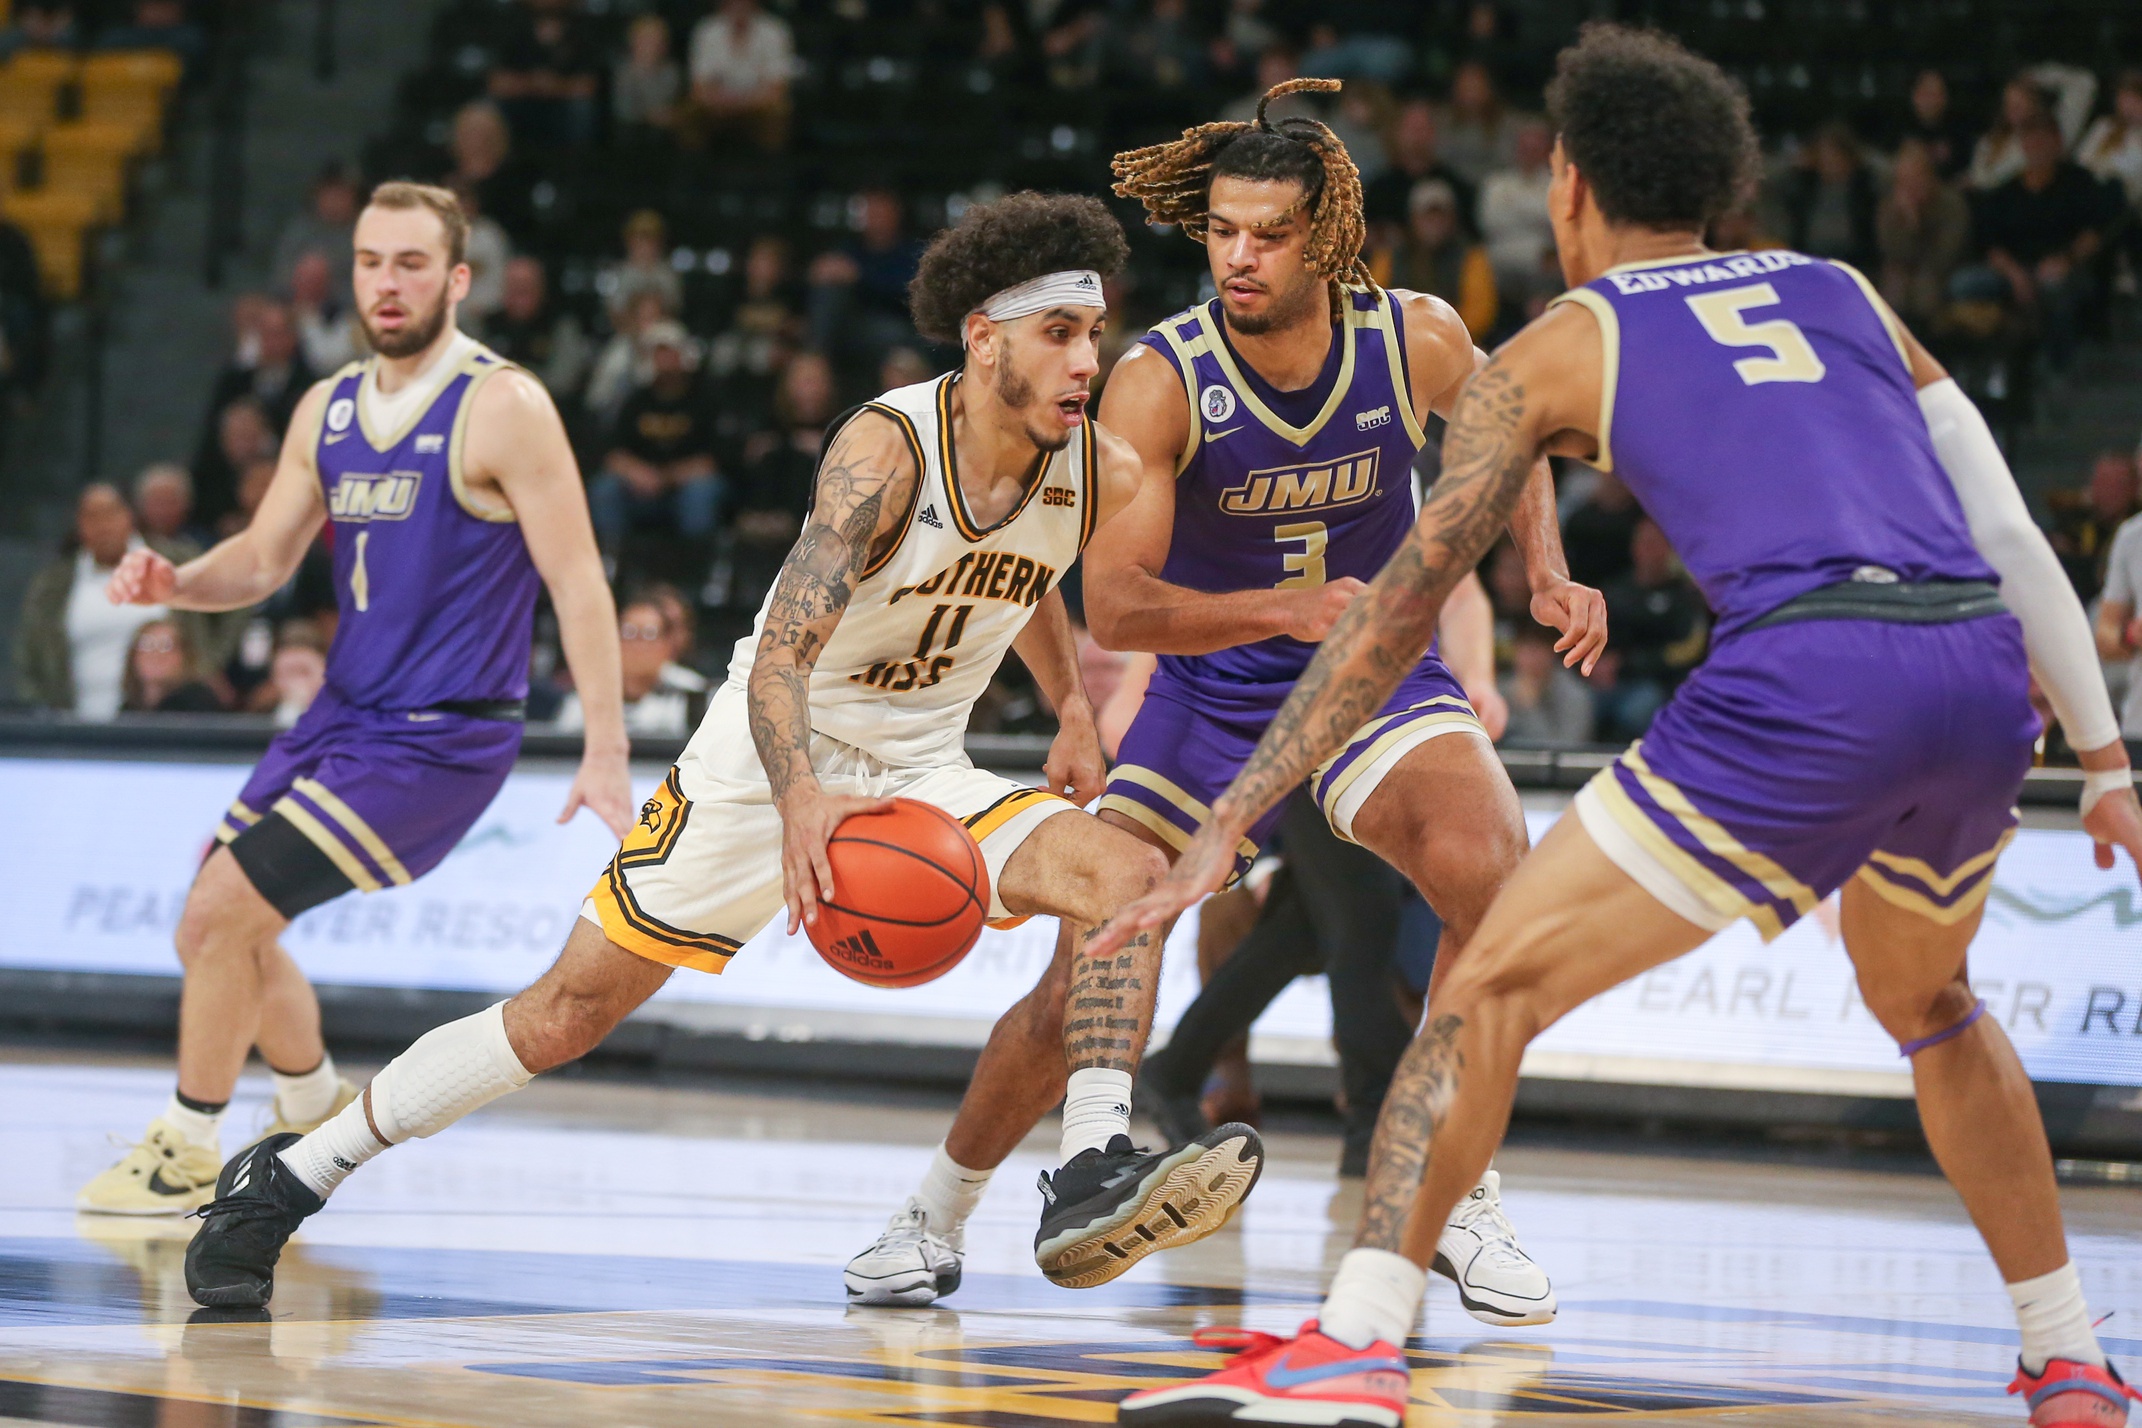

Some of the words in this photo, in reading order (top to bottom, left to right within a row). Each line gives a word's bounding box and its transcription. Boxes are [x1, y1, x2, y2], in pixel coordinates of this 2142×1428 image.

[1684, 282, 1826, 386] 5
[1355, 405, 1391, 431] SBC
[330, 478, 415, 518] JMU
[1043, 486, 1076, 508] SBC
[1227, 457, 1373, 511] JMU
[918, 513, 943, 530] adidas
[351, 531, 369, 612] 1
[1274, 521, 1329, 589] 3
[912, 603, 976, 661] 11
[829, 944, 895, 969] adidas
[1637, 963, 1809, 1021] EARL
